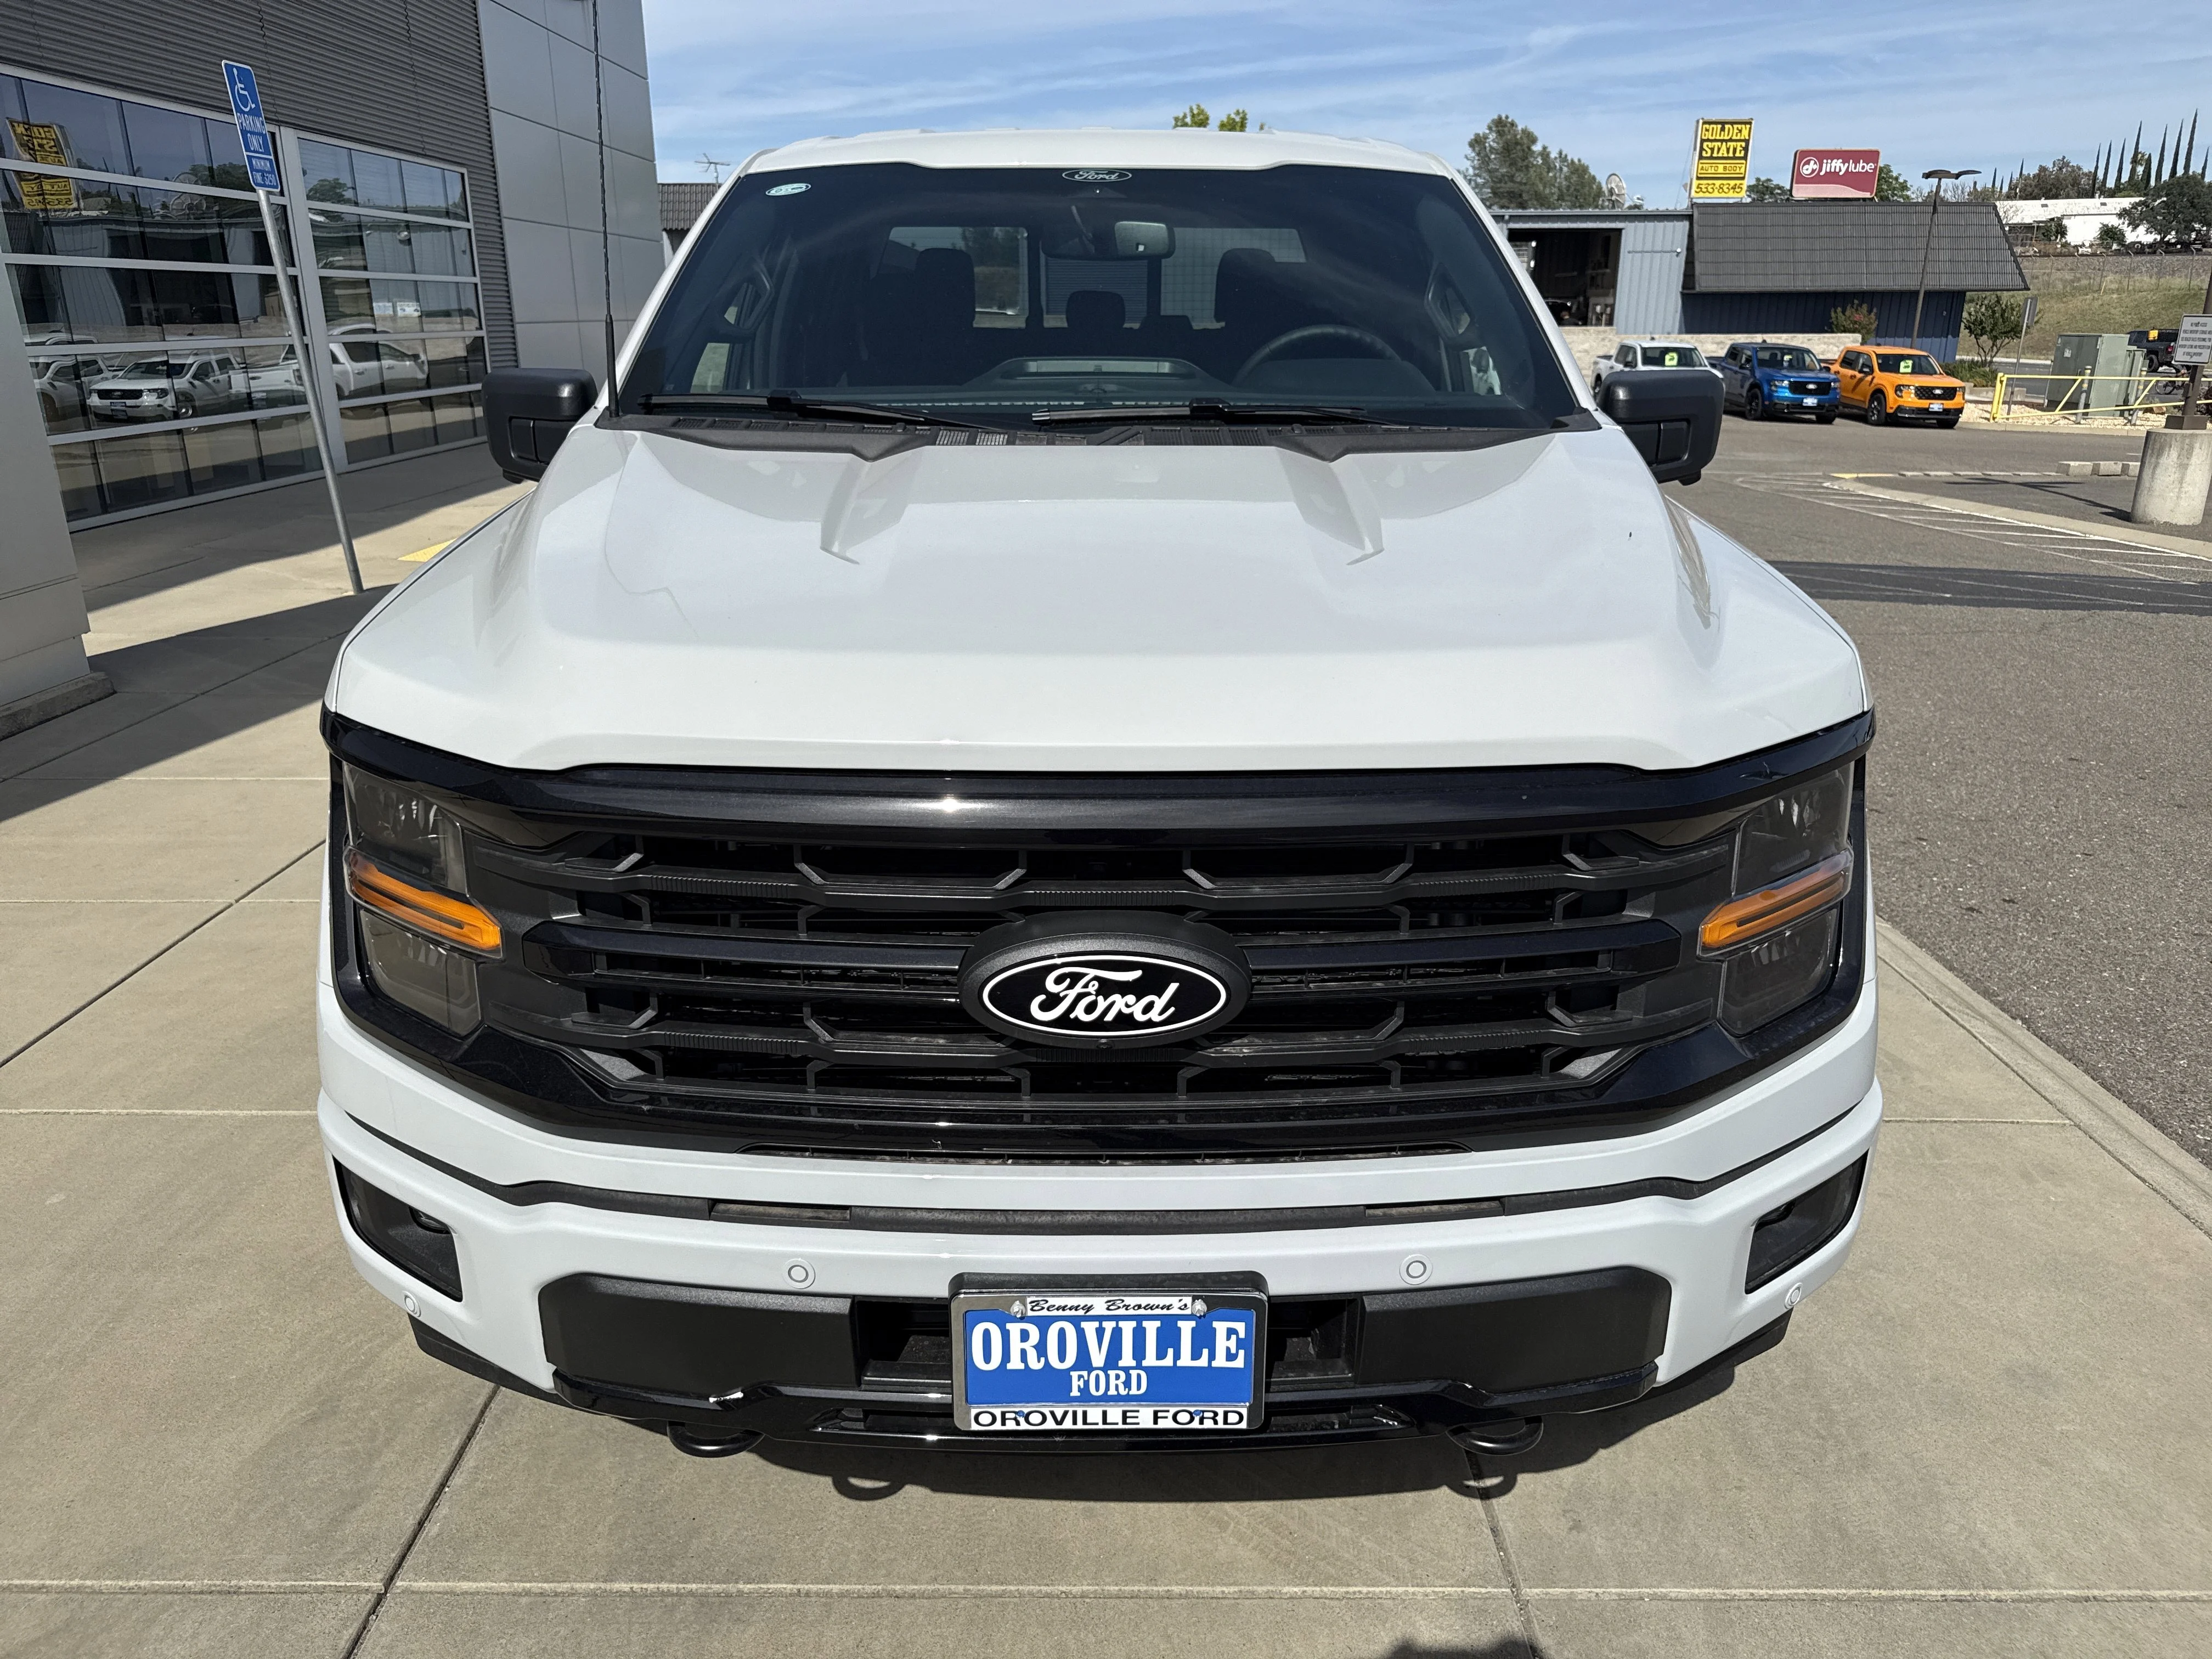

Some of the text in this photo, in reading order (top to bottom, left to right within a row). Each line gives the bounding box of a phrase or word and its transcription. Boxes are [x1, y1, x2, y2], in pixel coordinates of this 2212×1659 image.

[237, 113, 266, 134] PARKING
[1702, 124, 1751, 139] GOLDEN
[247, 133, 264, 152] ONLY
[1702, 142, 1745, 157] STATE
[253, 172, 264, 184] FINE
[1074, 170, 1119, 179] Ford
[1030, 966, 1180, 1022] Ford
[1029, 1299, 1190, 1314] Benny Brown's
[971, 1319, 1246, 1371] OROVILLE
[1070, 1369, 1148, 1397] FORD
[973, 1409, 1244, 1427] OROVILLE FORD
